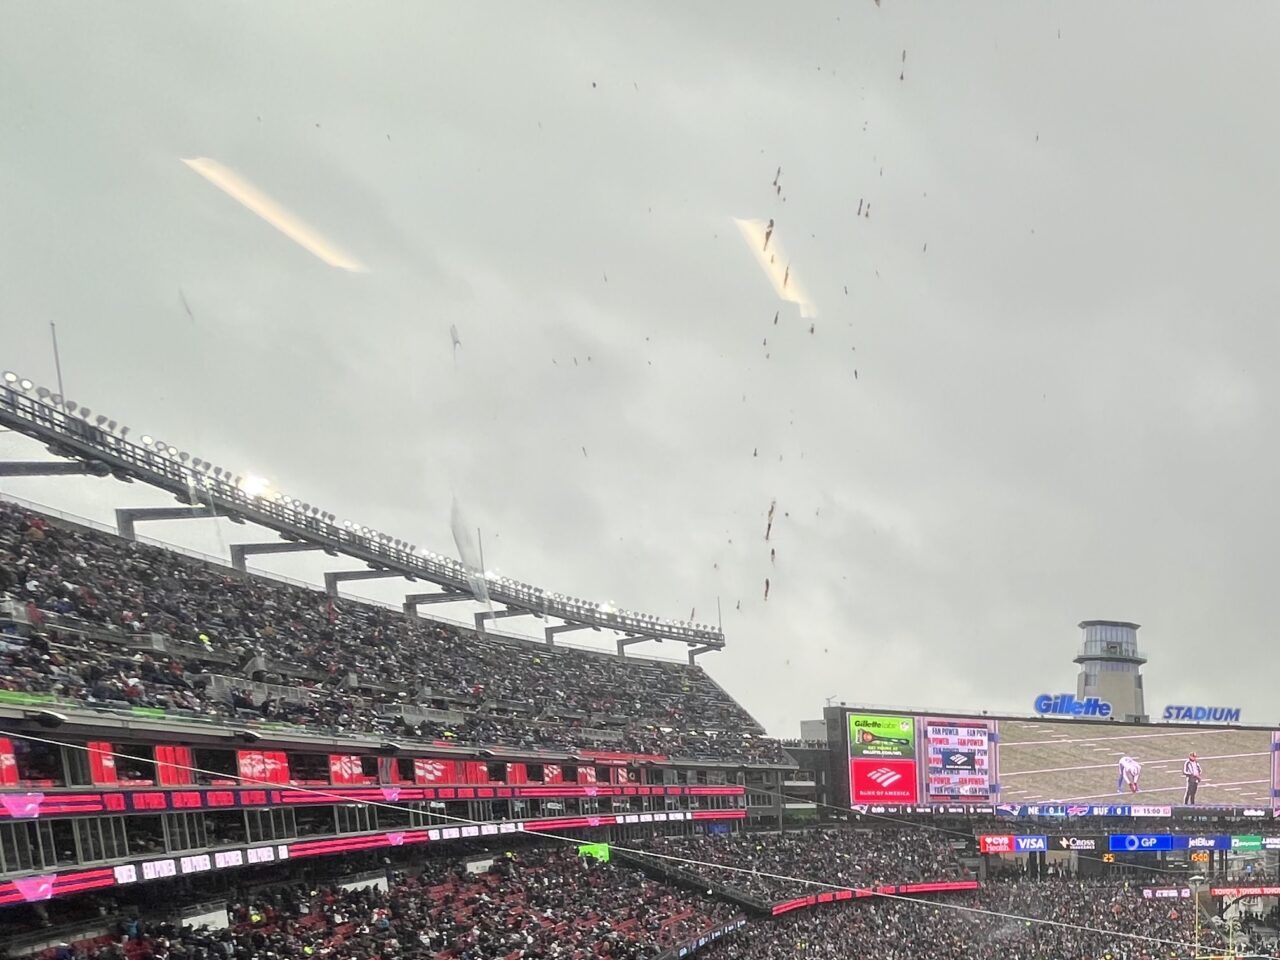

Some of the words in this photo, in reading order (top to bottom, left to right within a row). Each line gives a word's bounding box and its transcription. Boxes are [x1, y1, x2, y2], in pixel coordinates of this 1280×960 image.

[1034, 694, 1112, 716] Gillette
[1163, 705, 1240, 722] STADIUM
[942, 728, 958, 736] POWER
[1028, 806, 1039, 815] NE
[1093, 807, 1109, 815] BUF
[1017, 838, 1045, 849] VISA
[1069, 837, 1095, 846] Cross
[1141, 838, 1157, 847] GP
[1188, 837, 1216, 848] jetBlue
[986, 843, 1009, 852] Health
[1103, 853, 1114, 862] 25
